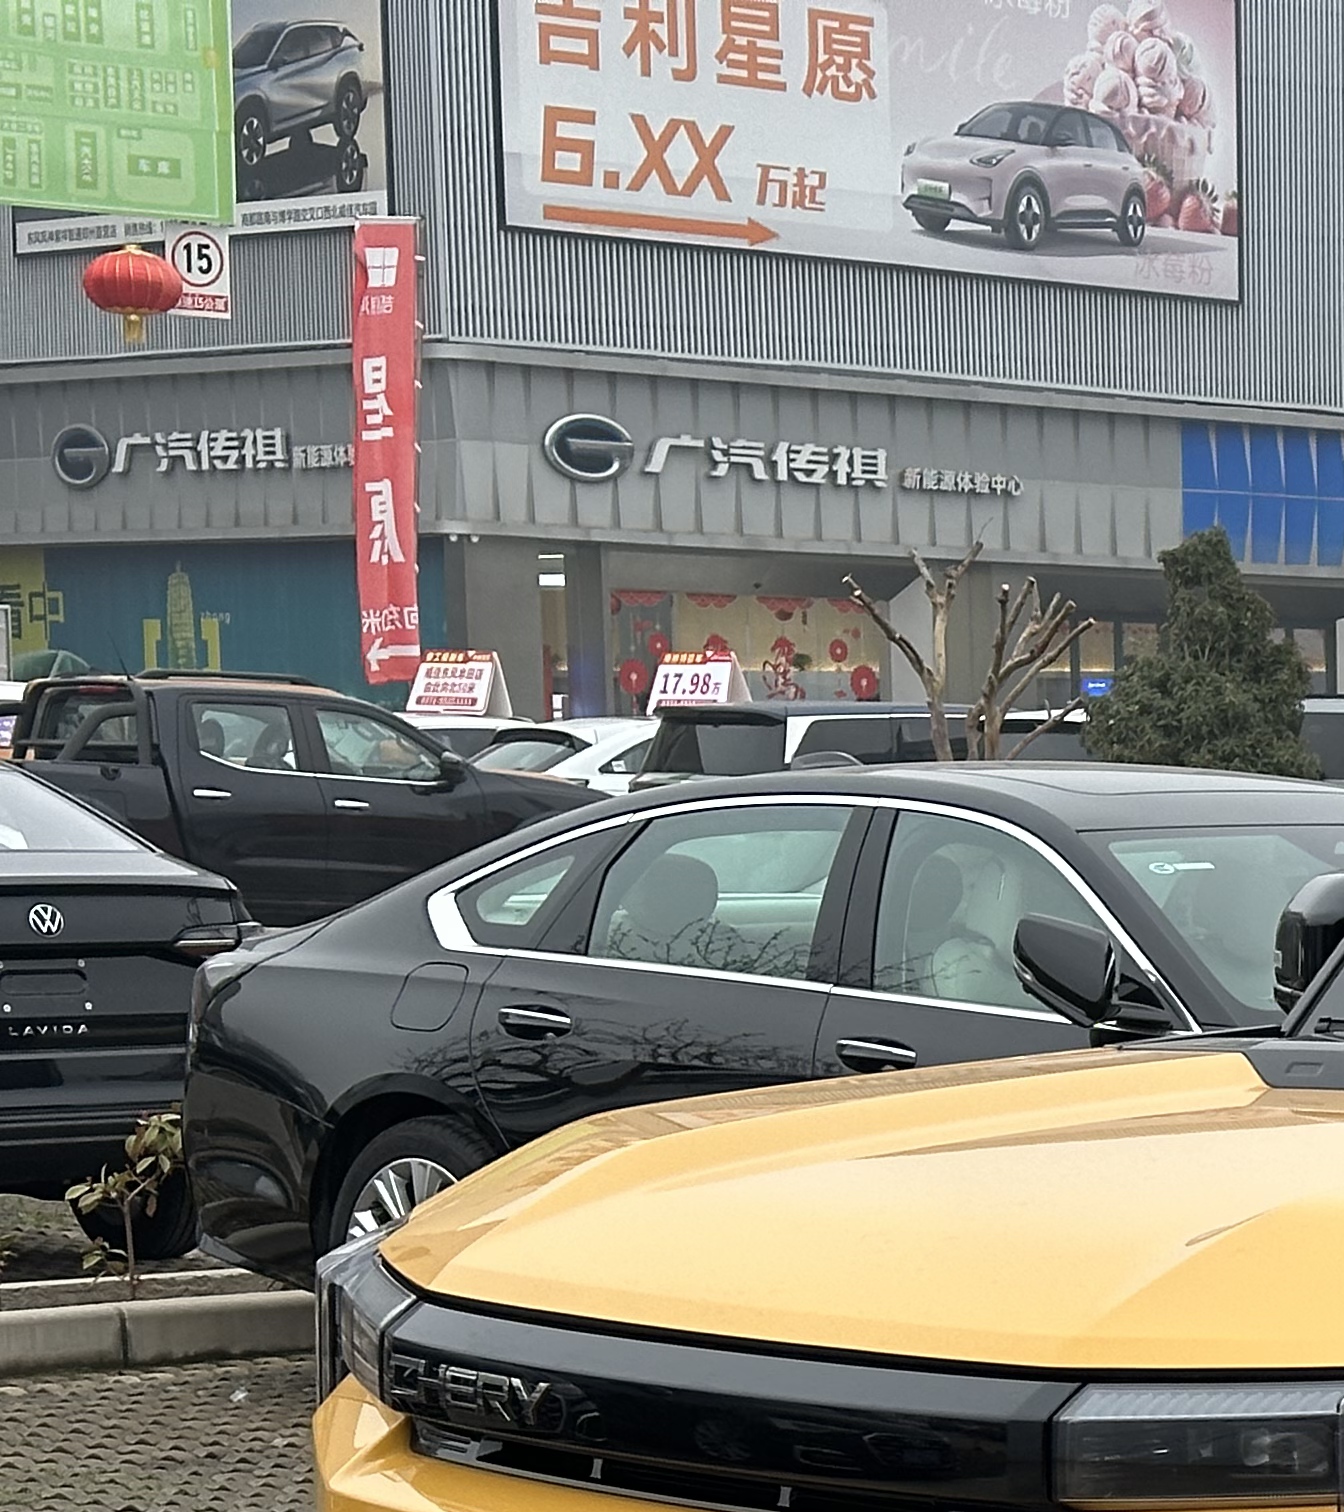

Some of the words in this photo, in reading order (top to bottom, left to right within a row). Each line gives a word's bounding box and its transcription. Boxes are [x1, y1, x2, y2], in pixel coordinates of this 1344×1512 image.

[537, 0, 878, 102] 吉利星愿
[541, 104, 735, 202] 6.XX
[756, 163, 827, 212] 万起
[183, 243, 213, 274] 15
[111, 427, 289, 473] 广汽传祺
[644, 433, 888, 488] 广汽传祺
[902, 466, 1025, 497] 新能源体验中心
[9, 1023, 89, 1036] LAVIDA
